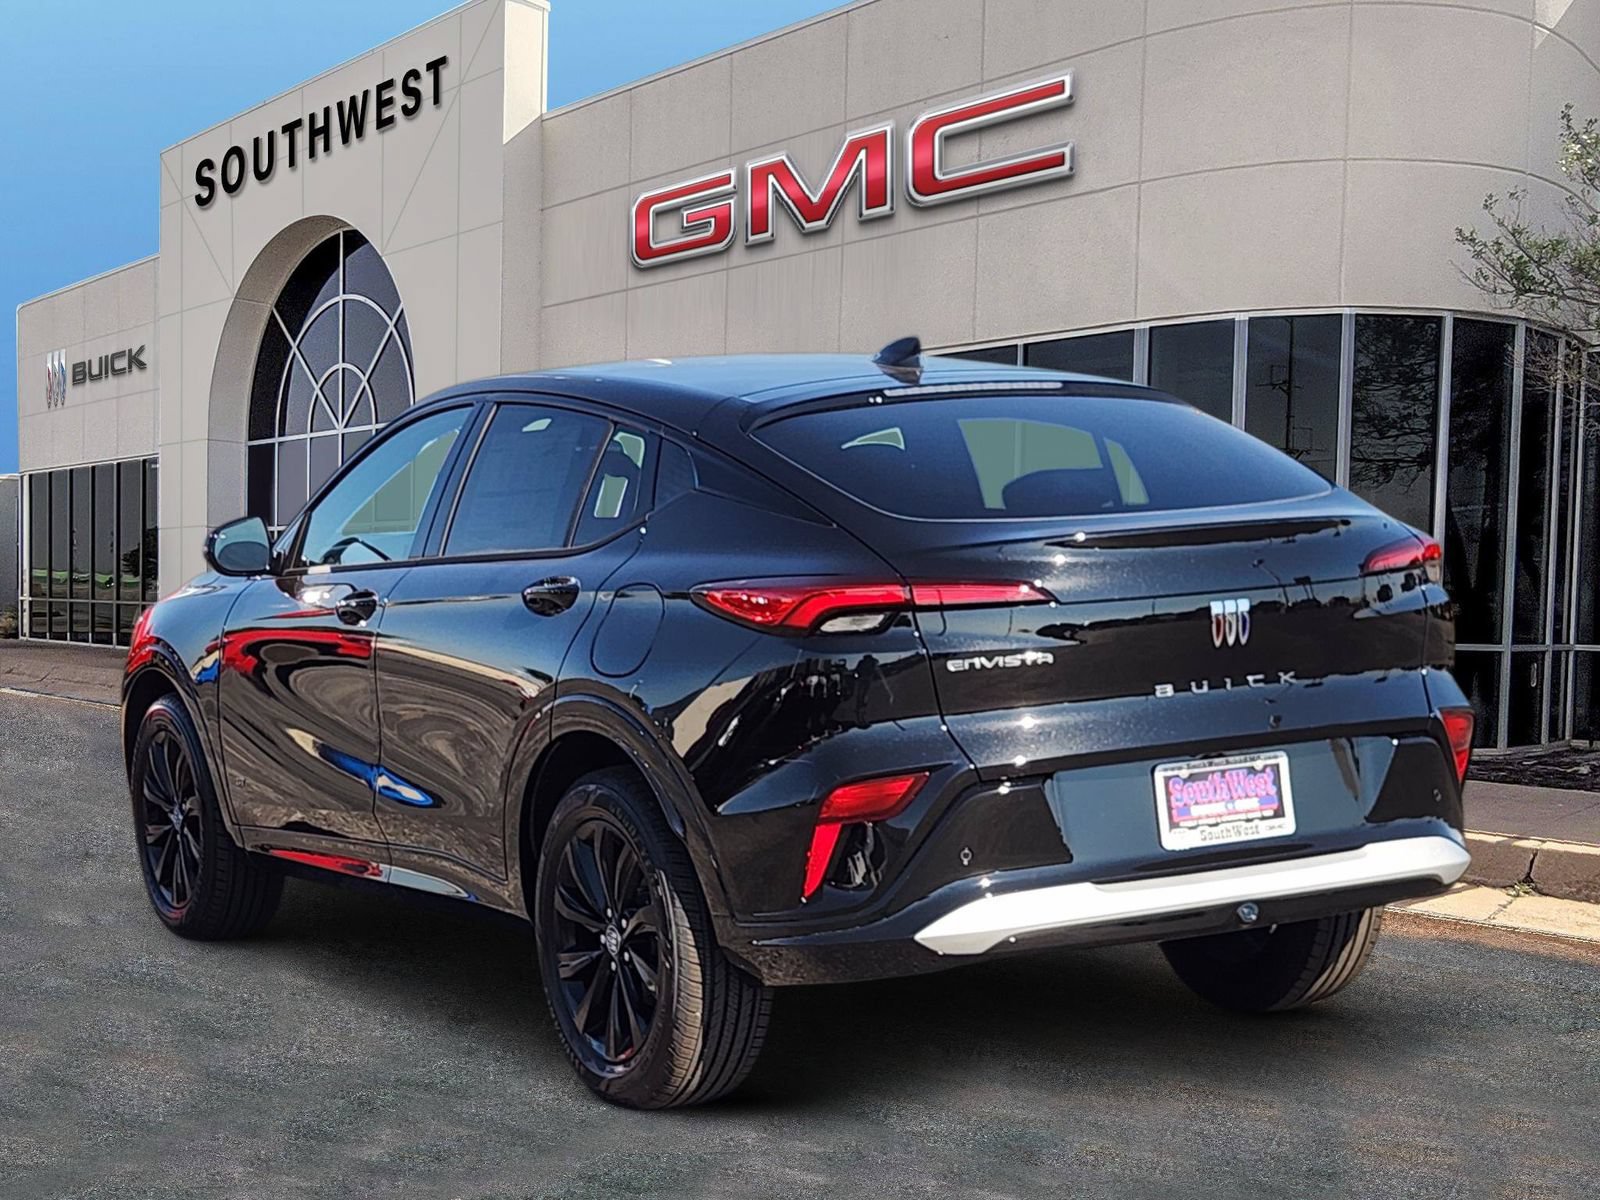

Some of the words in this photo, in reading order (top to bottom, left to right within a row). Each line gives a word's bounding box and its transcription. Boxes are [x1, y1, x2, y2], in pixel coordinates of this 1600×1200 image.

[195, 55, 448, 208] SOUTHWEST
[630, 70, 1075, 269] GMC
[72, 344, 147, 386] BUICK
[1155, 671, 1297, 698] BUICK
